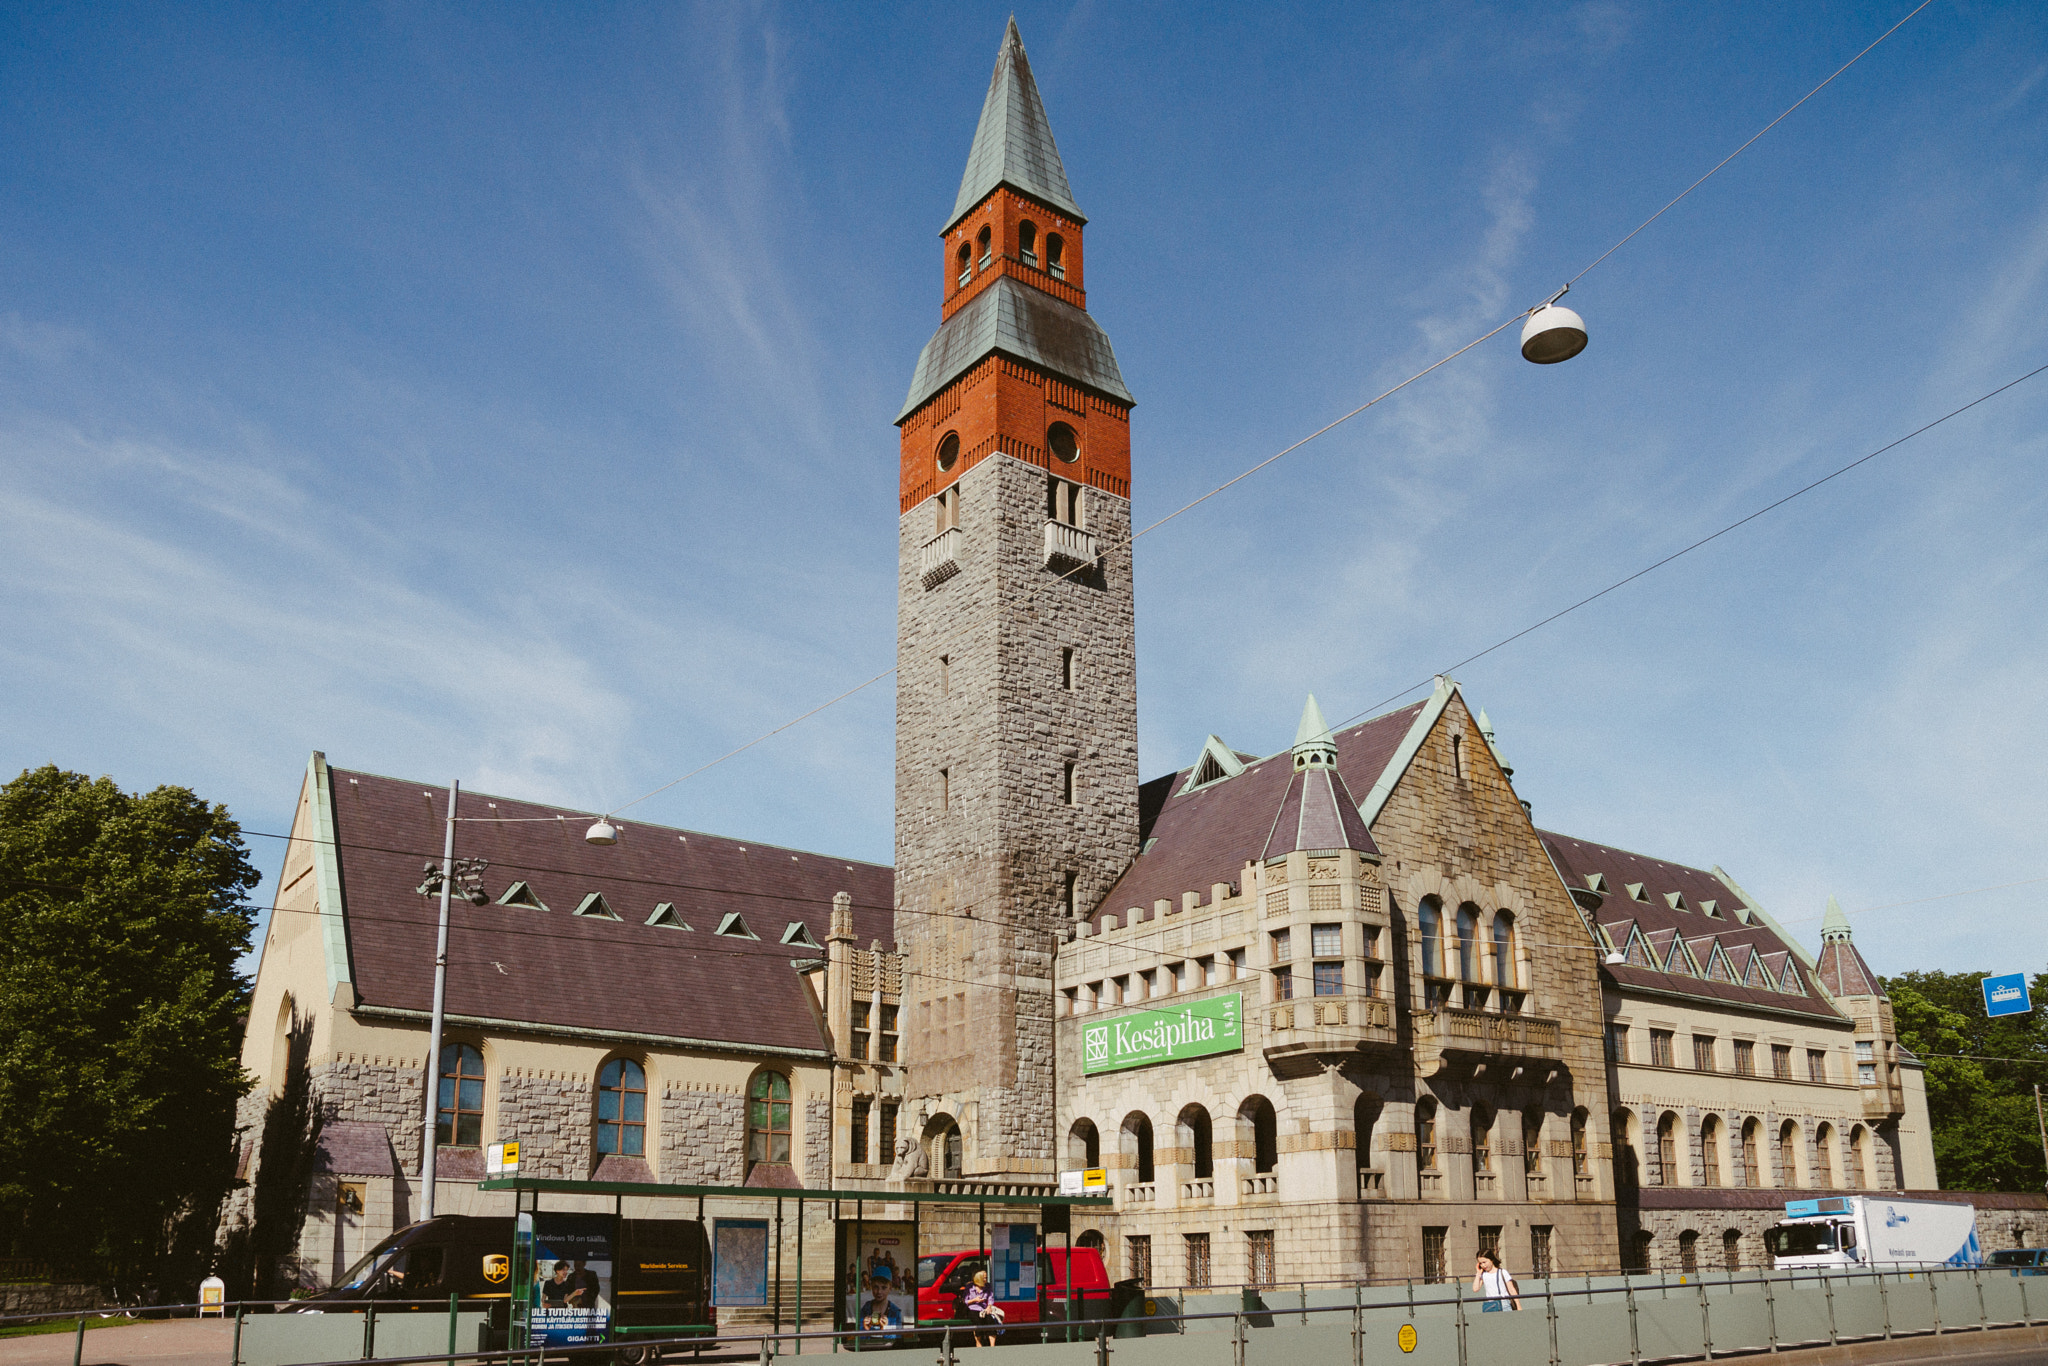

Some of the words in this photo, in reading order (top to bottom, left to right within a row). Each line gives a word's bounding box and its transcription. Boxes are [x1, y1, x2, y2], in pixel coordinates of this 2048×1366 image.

[1114, 1009, 1216, 1056] Kesäpiha
[485, 1262, 507, 1279] ups
[531, 1308, 546, 1316] ULE
[548, 1308, 606, 1316] TUTUSTUMAAN
